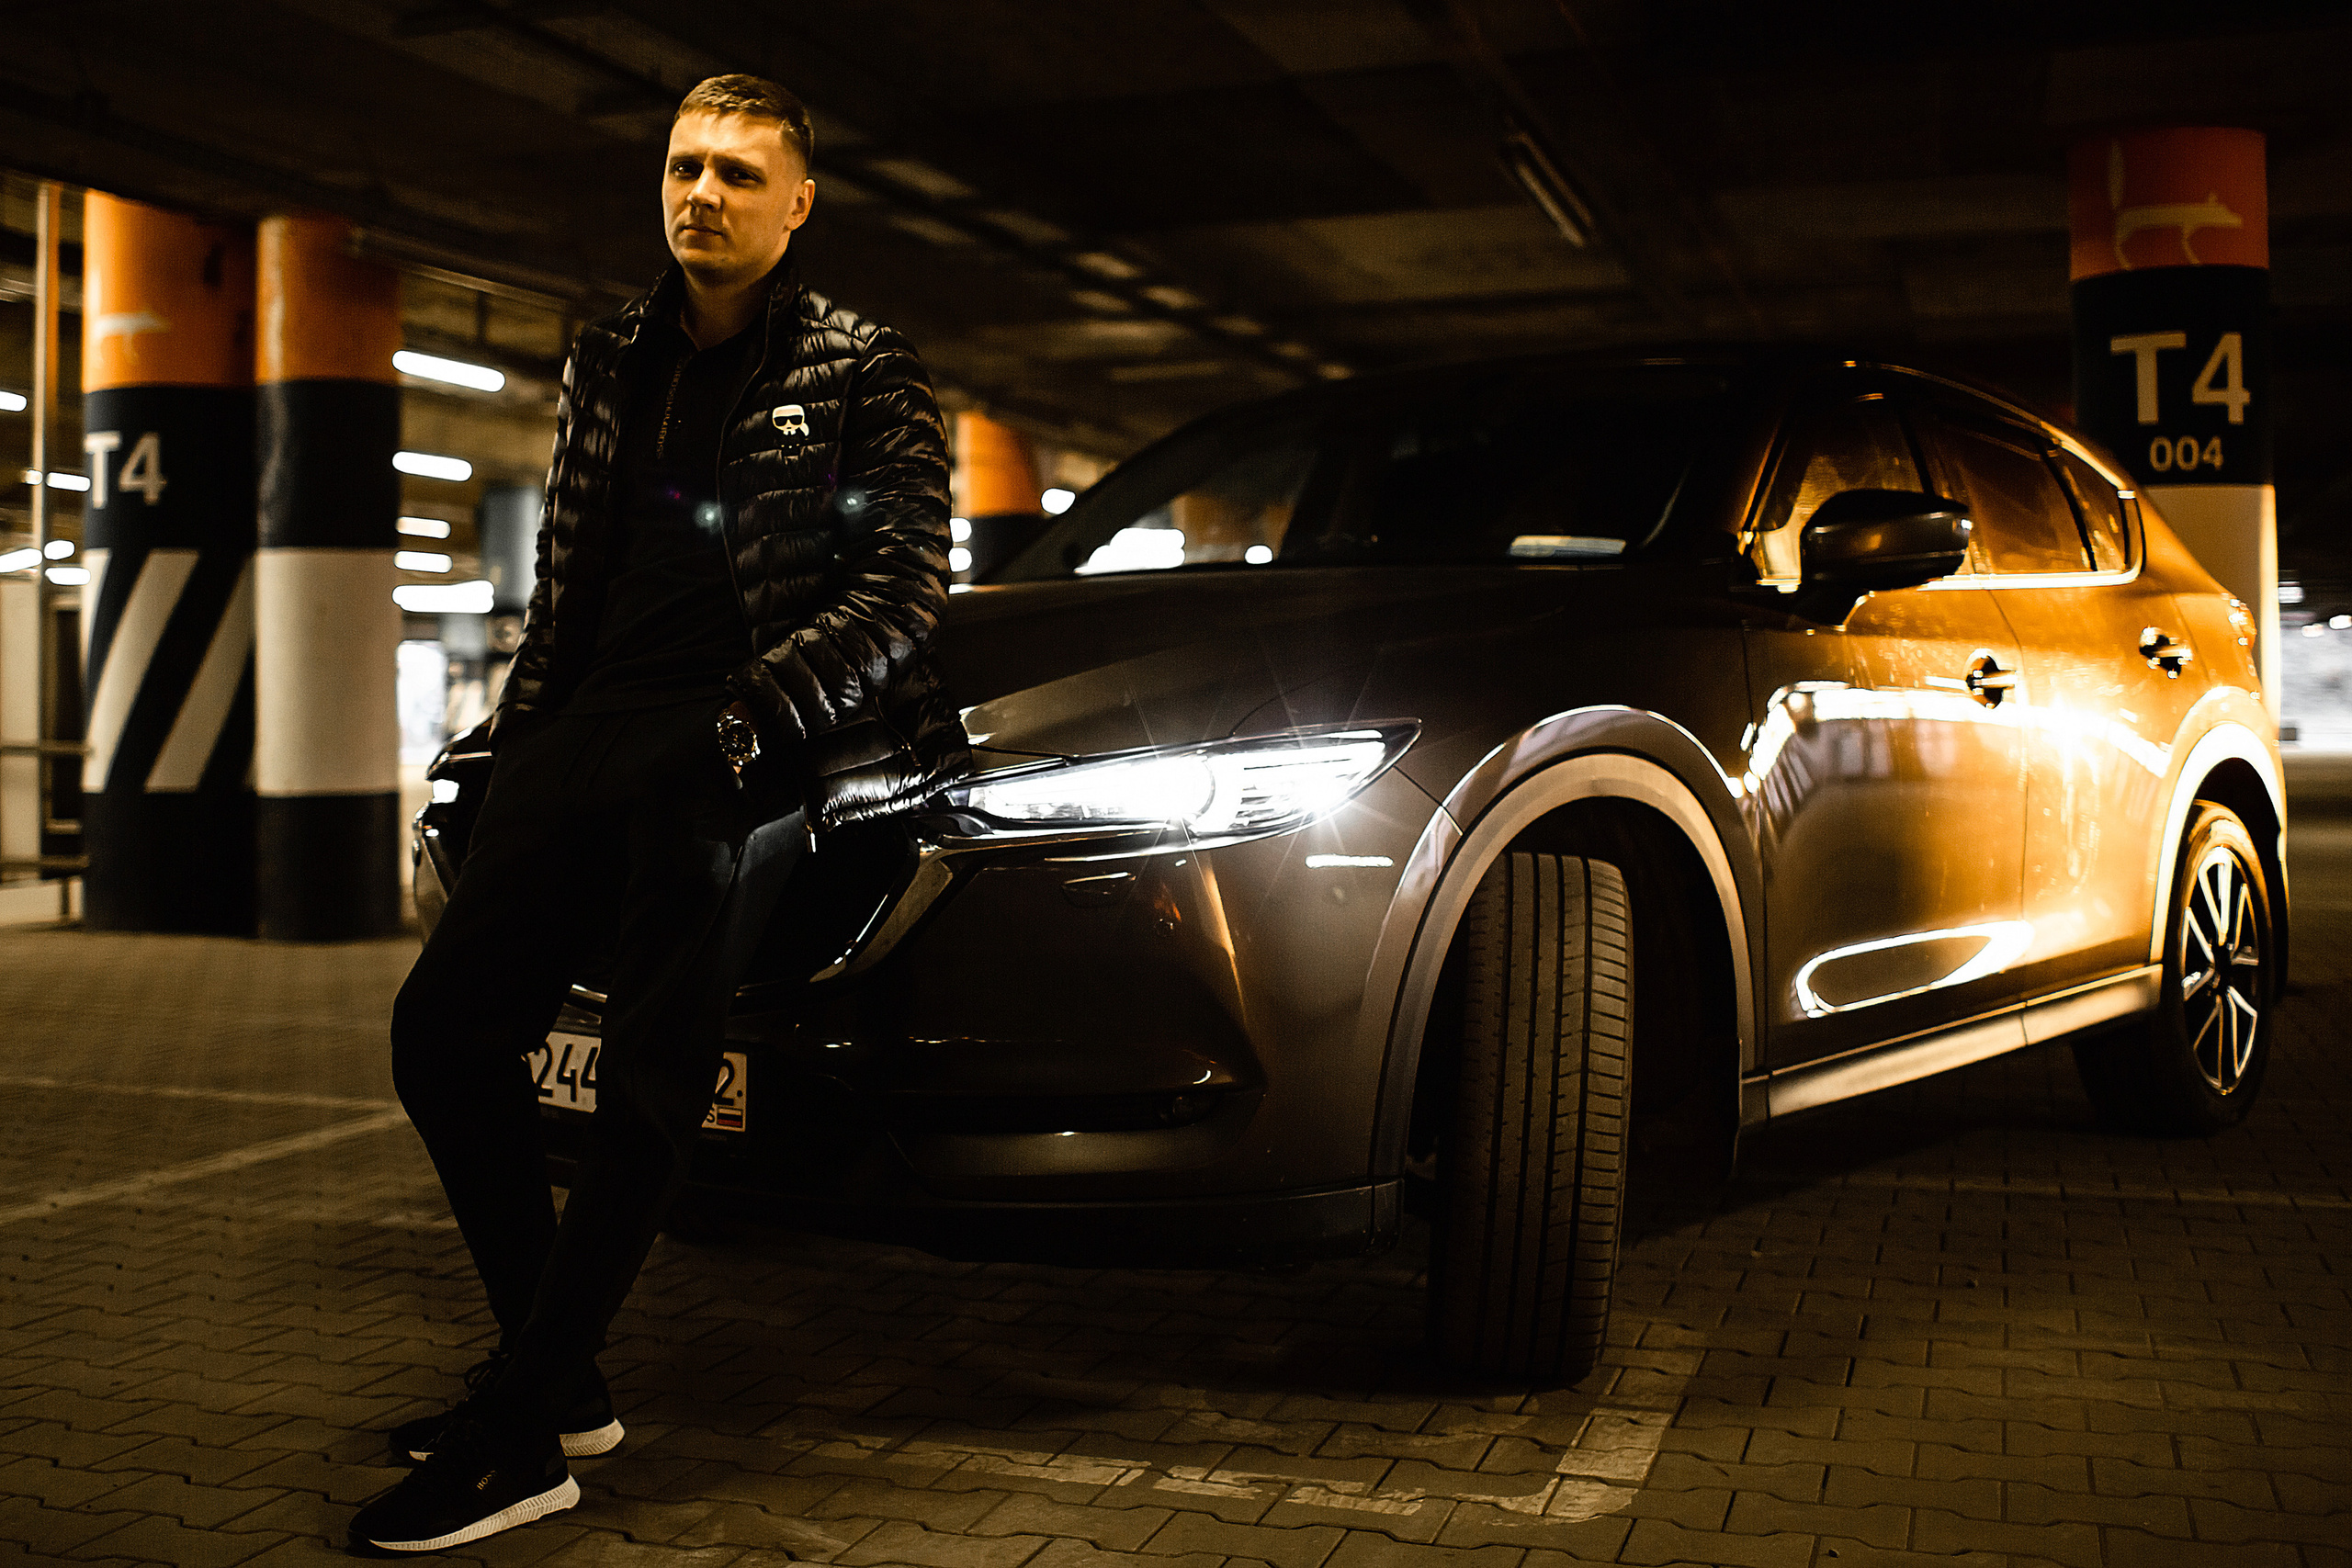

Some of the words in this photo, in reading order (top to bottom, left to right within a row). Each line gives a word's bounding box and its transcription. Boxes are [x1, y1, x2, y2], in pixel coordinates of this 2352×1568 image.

[2110, 330, 2251, 425] T4
[83, 430, 167, 510] T4
[2150, 435, 2224, 471] 004
